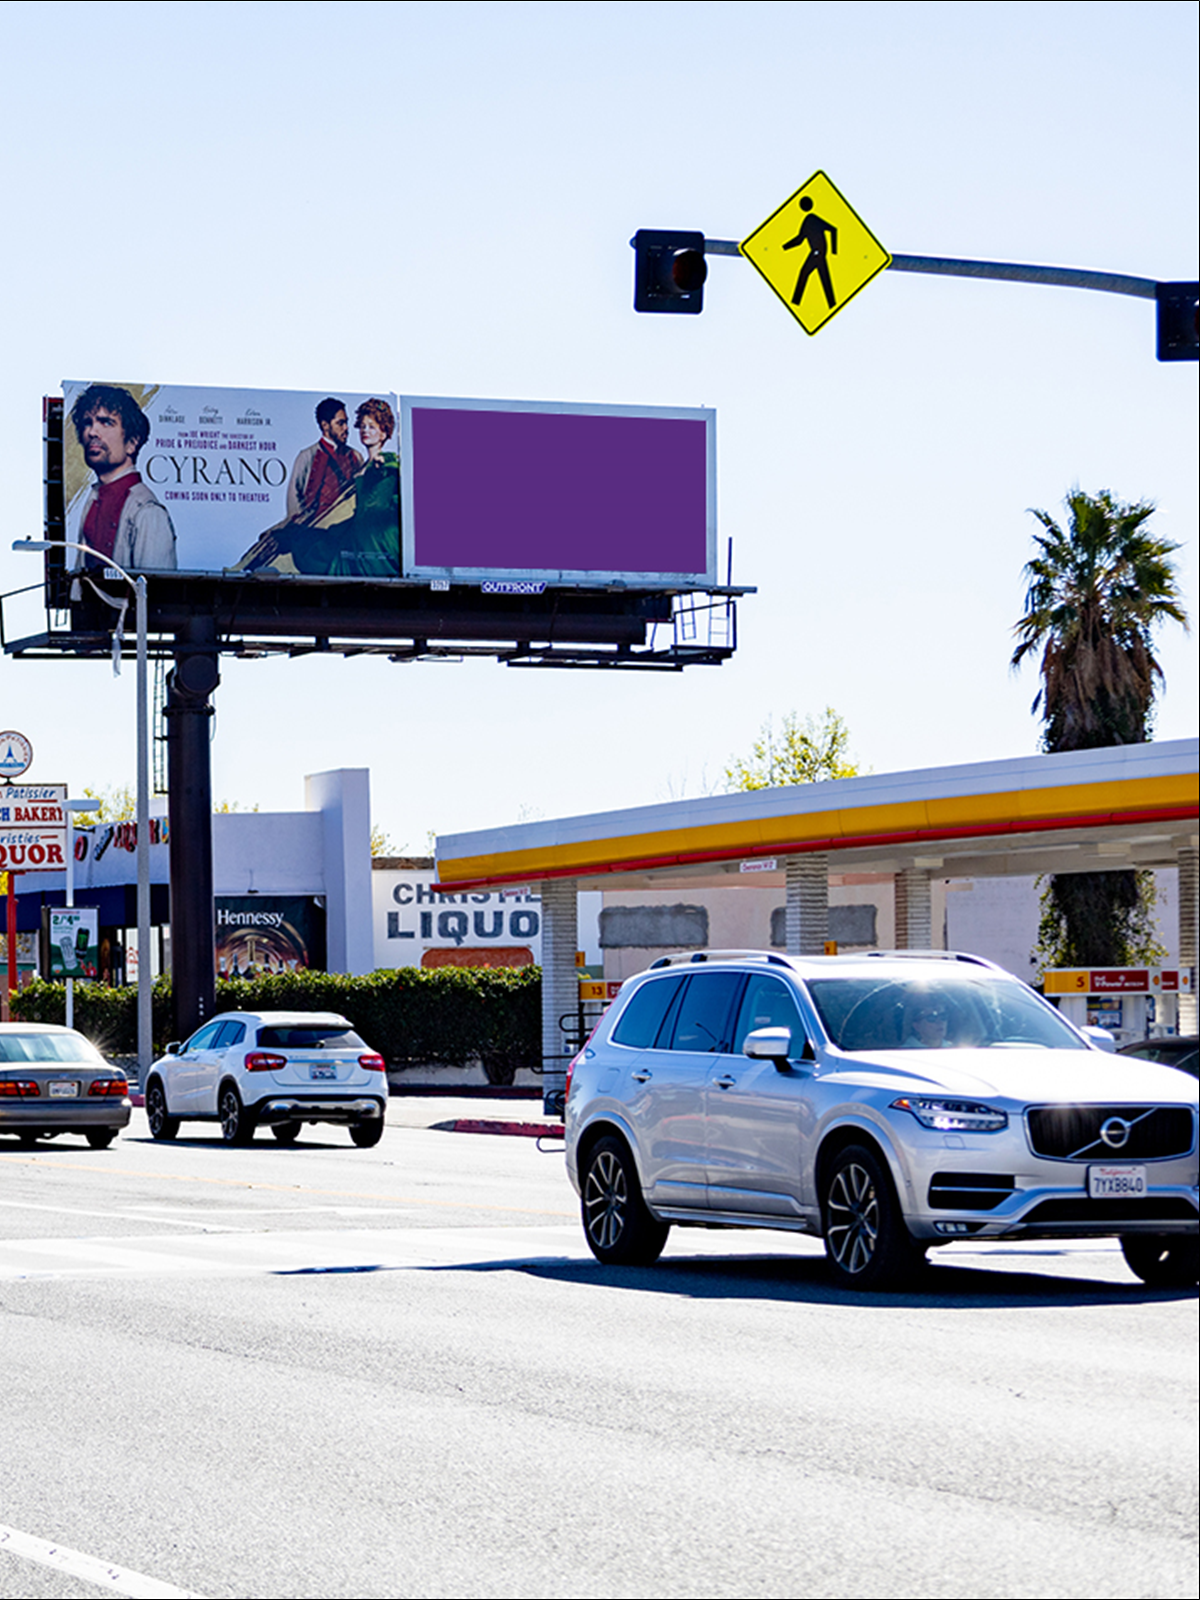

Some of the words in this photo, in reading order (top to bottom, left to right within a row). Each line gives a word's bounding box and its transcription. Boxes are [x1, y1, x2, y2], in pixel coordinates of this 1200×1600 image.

[155, 438, 175, 448] PRIDE
[184, 440, 218, 450] PREJUDICE
[228, 441, 257, 451] DARKEST
[259, 442, 277, 452] HOUR
[146, 454, 287, 487] CYRANO
[164, 491, 190, 501] COMING
[191, 491, 209, 501] SOON
[210, 492, 227, 501] ONLY
[228, 492, 237, 502] TO
[238, 493, 271, 503] THEATERS
[483, 580, 542, 593] OUTFRONT
[5, 787, 56, 799] Patissier
[14, 806, 63, 821] BAKERY
[217, 909, 284, 928] Hennessy
[1076, 976, 1085, 988] 5
[591, 986, 602, 996] 13
